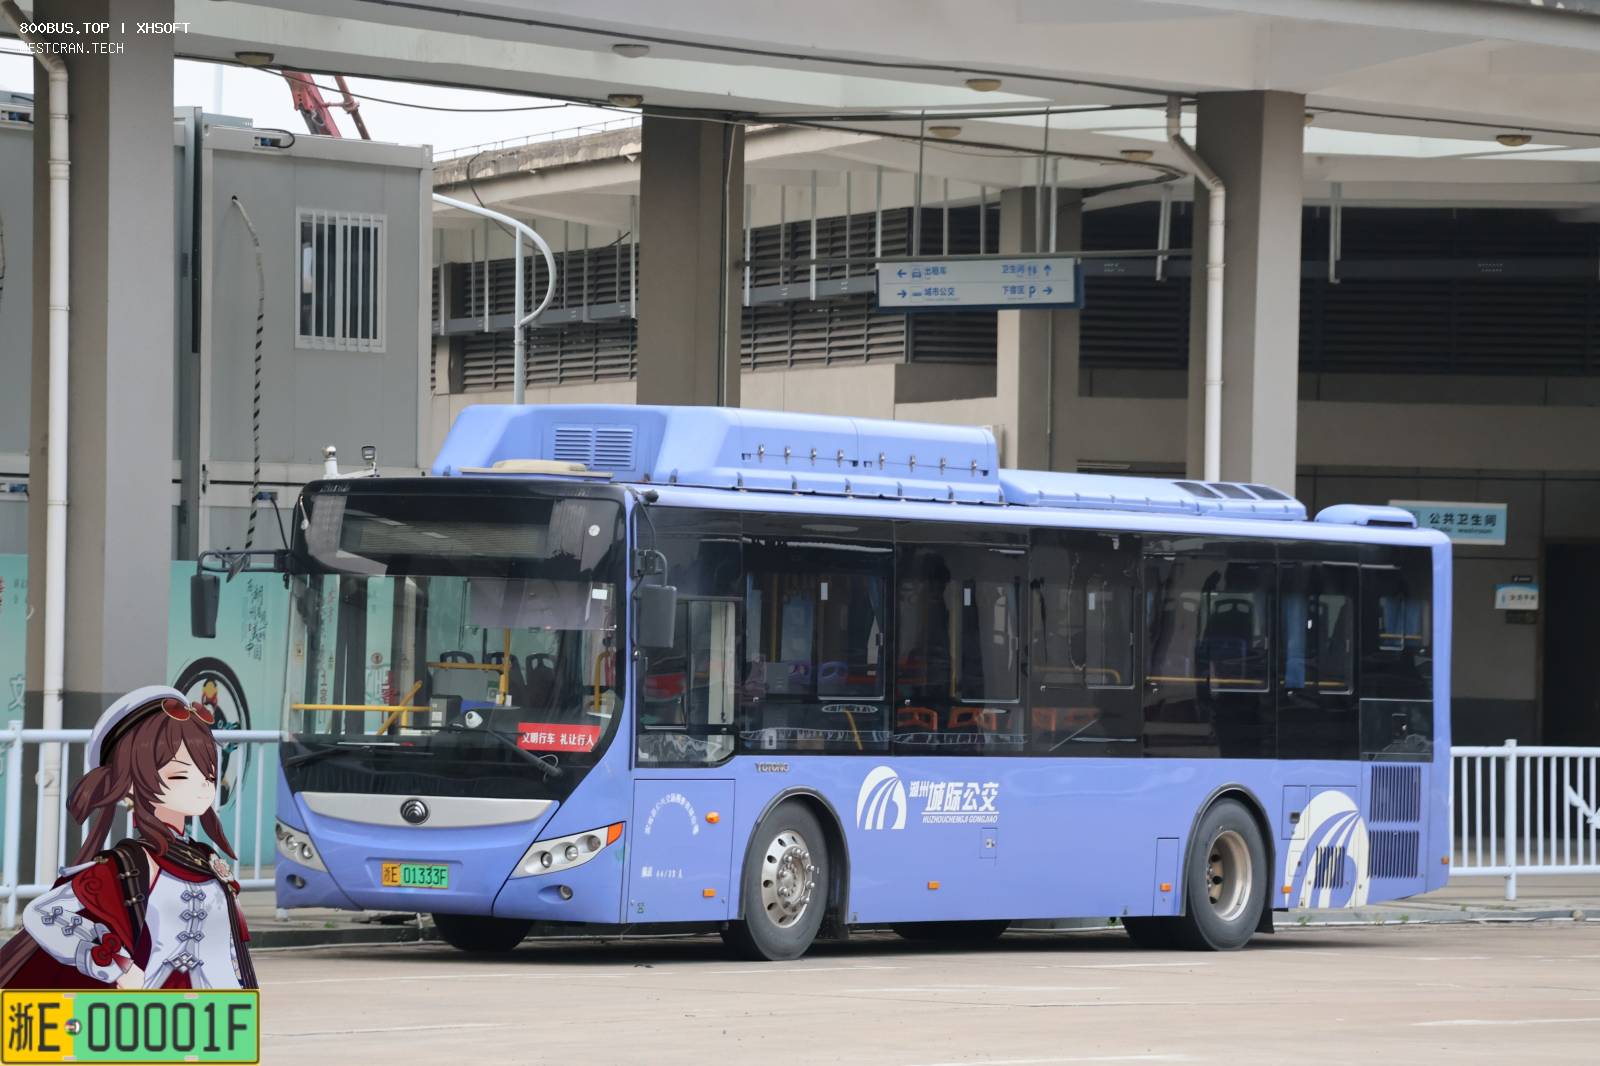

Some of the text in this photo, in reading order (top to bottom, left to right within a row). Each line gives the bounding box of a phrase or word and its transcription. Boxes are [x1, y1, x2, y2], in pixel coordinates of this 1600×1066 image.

[1429, 512, 1497, 527] 公共卫生间
[559, 732, 594, 746] 礼让行人
